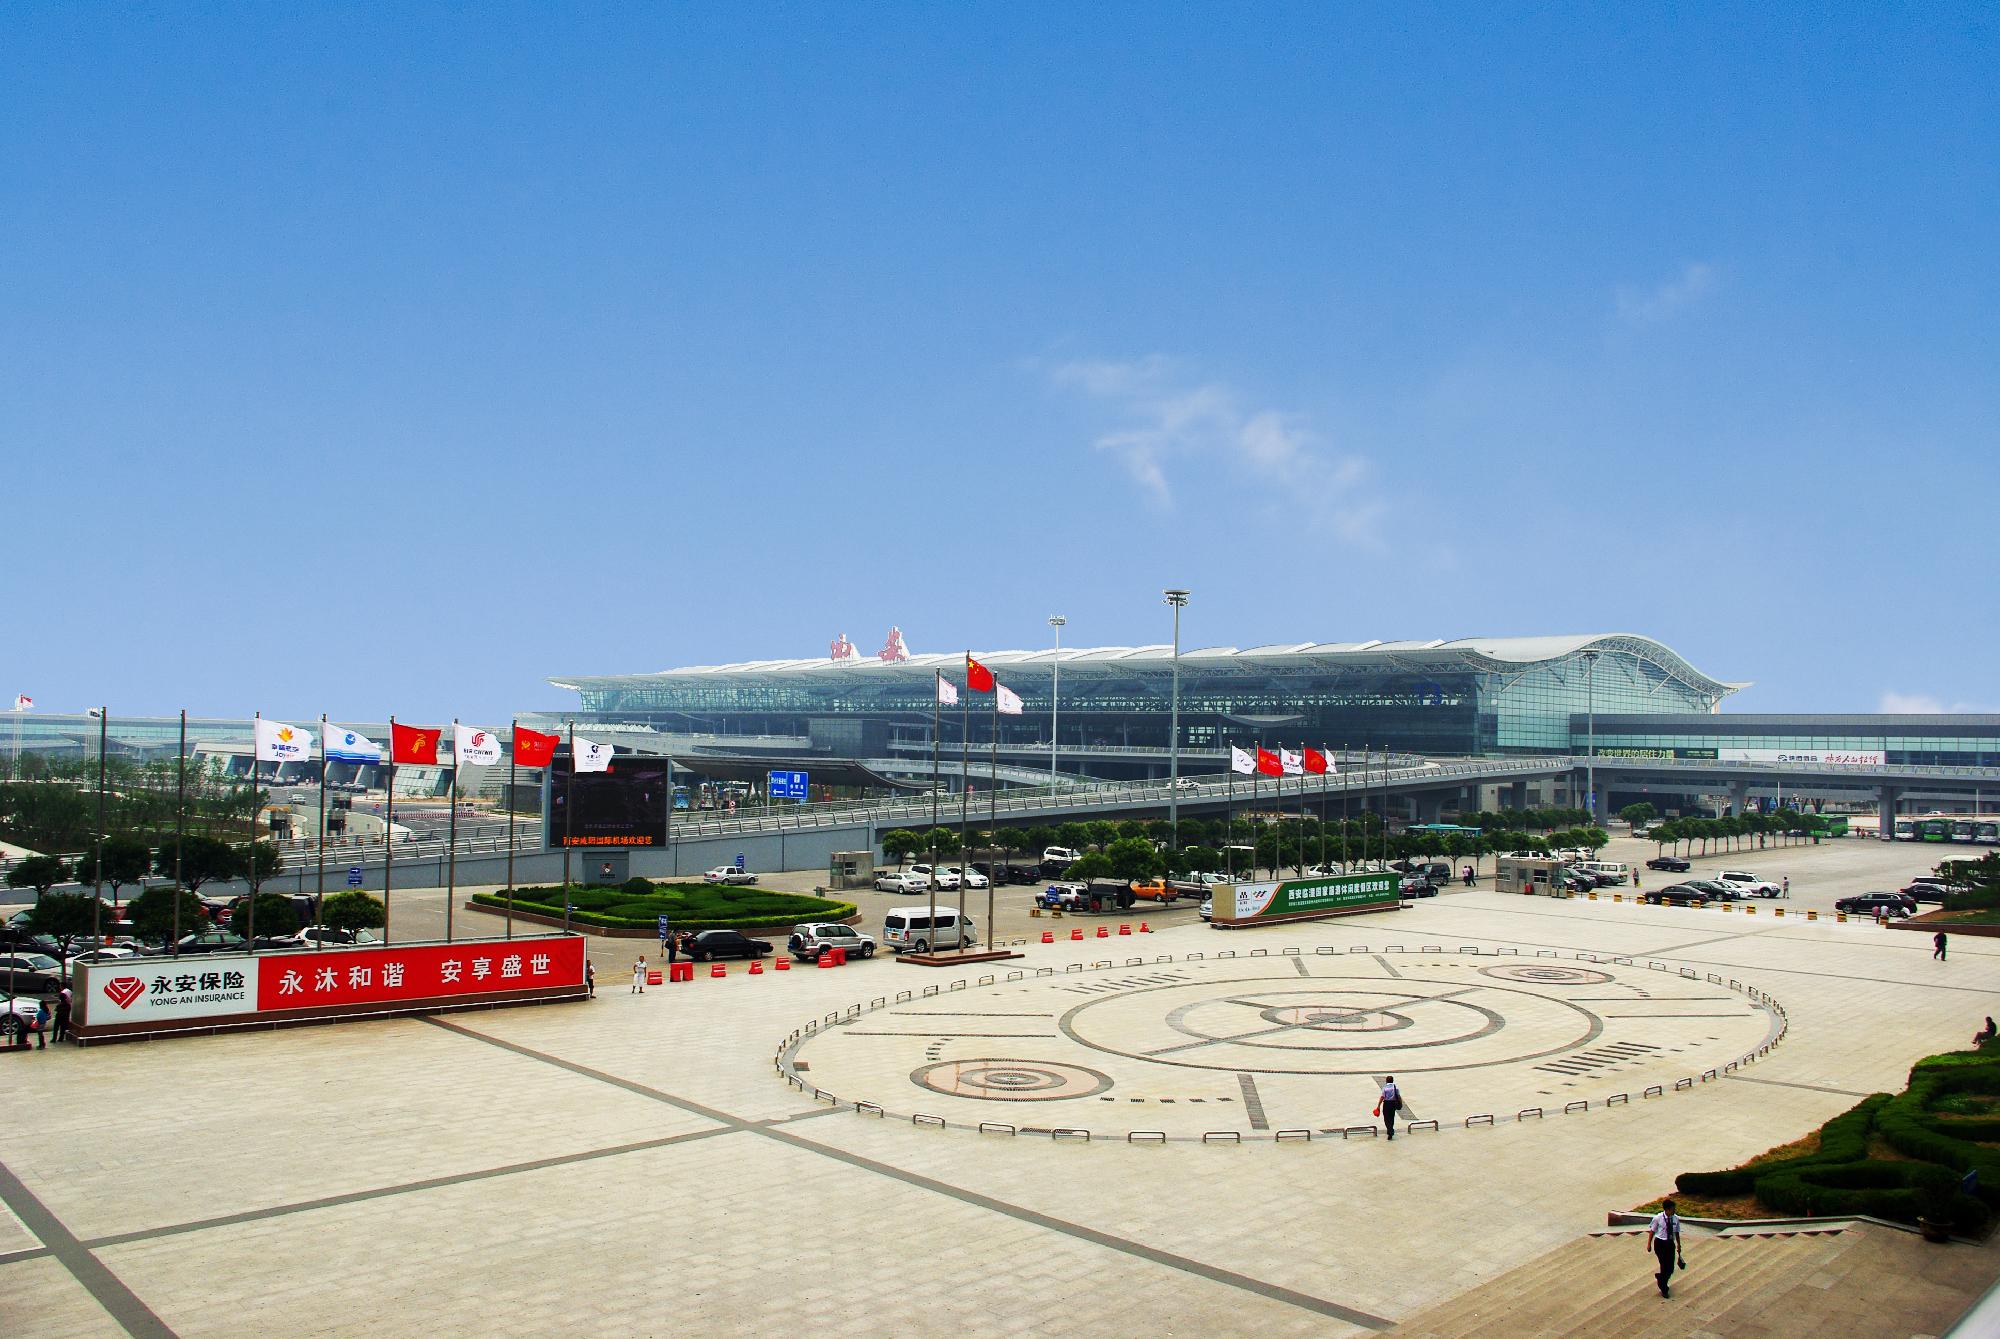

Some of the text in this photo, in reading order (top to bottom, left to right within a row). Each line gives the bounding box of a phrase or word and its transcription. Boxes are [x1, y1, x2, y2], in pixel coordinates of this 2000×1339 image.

[150, 971, 245, 995] 永安保险
[279, 954, 551, 995] 永沐和谐 安享盛世
[150, 992, 245, 1007] YONG AN INSURANCE
